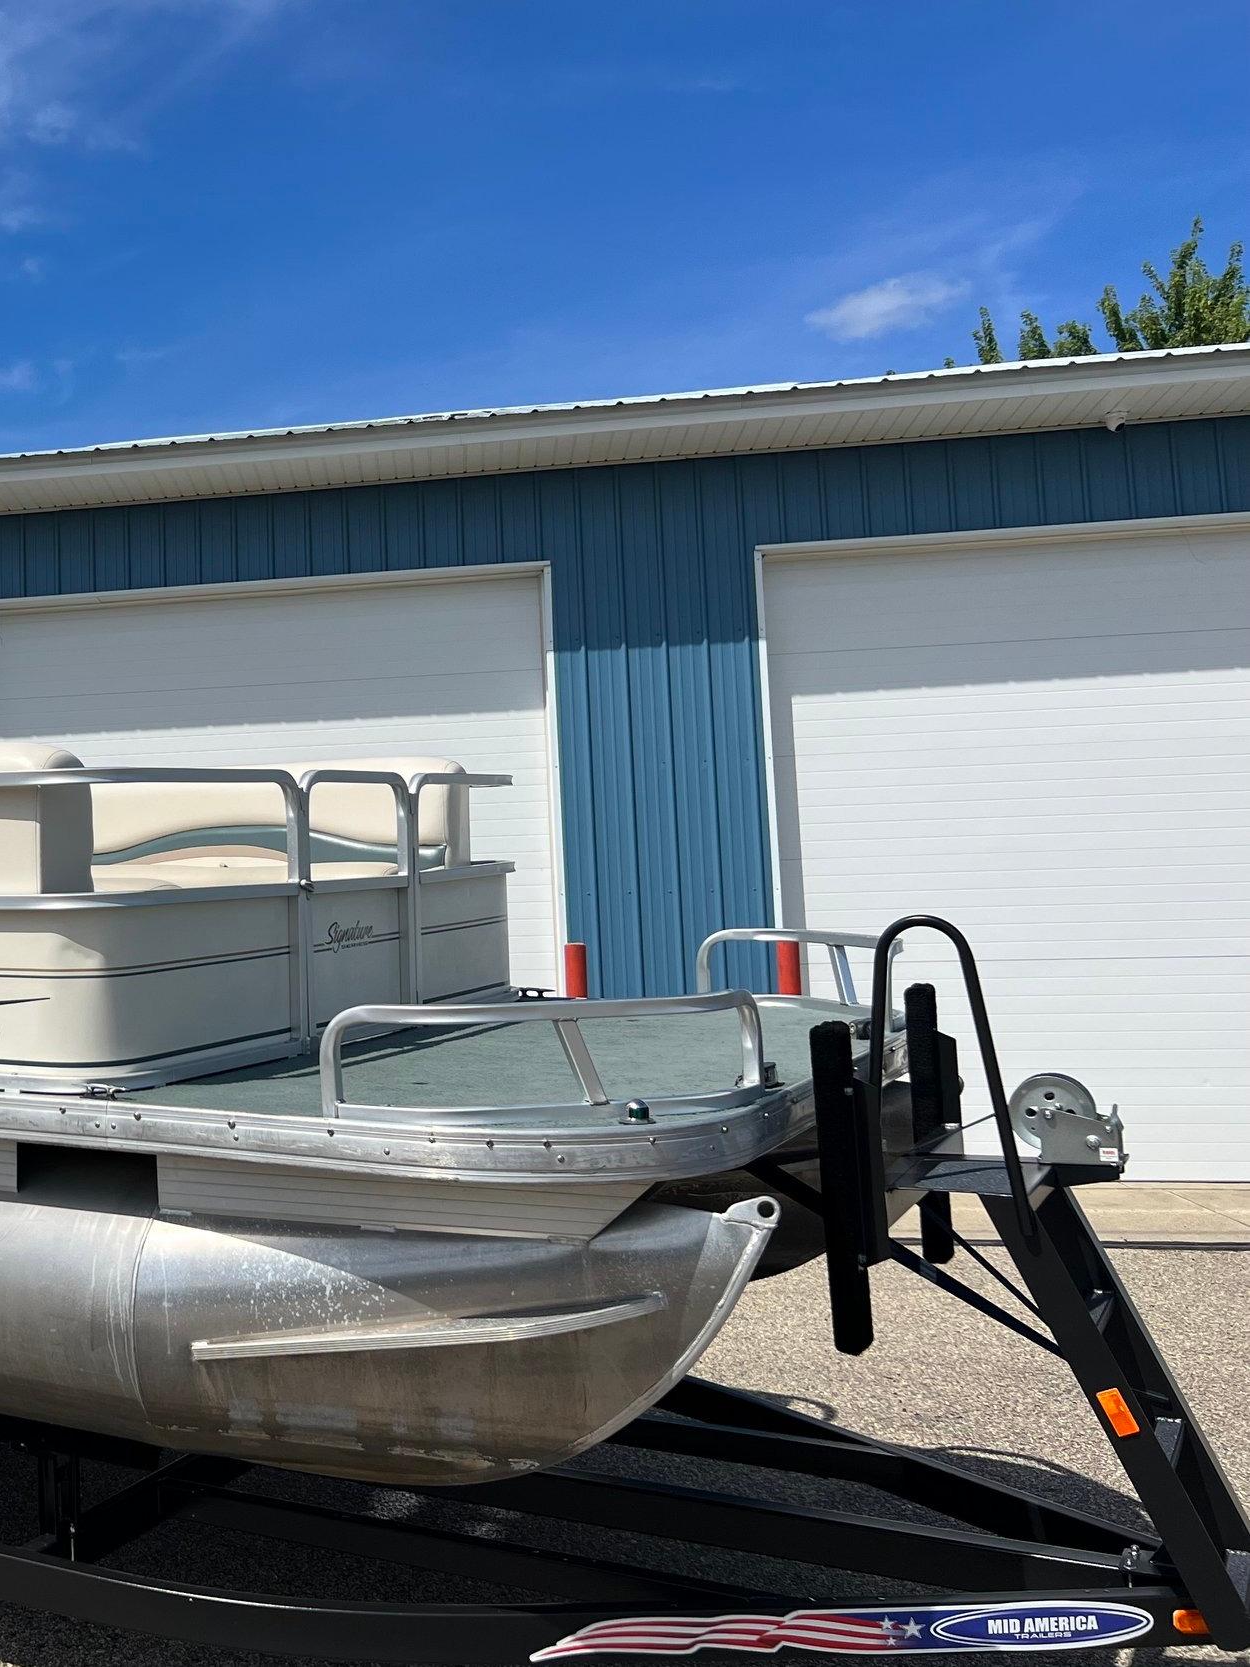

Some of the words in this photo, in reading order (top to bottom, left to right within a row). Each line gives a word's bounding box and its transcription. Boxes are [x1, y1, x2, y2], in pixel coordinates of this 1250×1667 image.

[324, 920, 374, 953] Signature
[987, 1618, 1021, 1635] MID
[1023, 1615, 1099, 1633] AMERICA
[1014, 1631, 1072, 1640] TRAILERS
